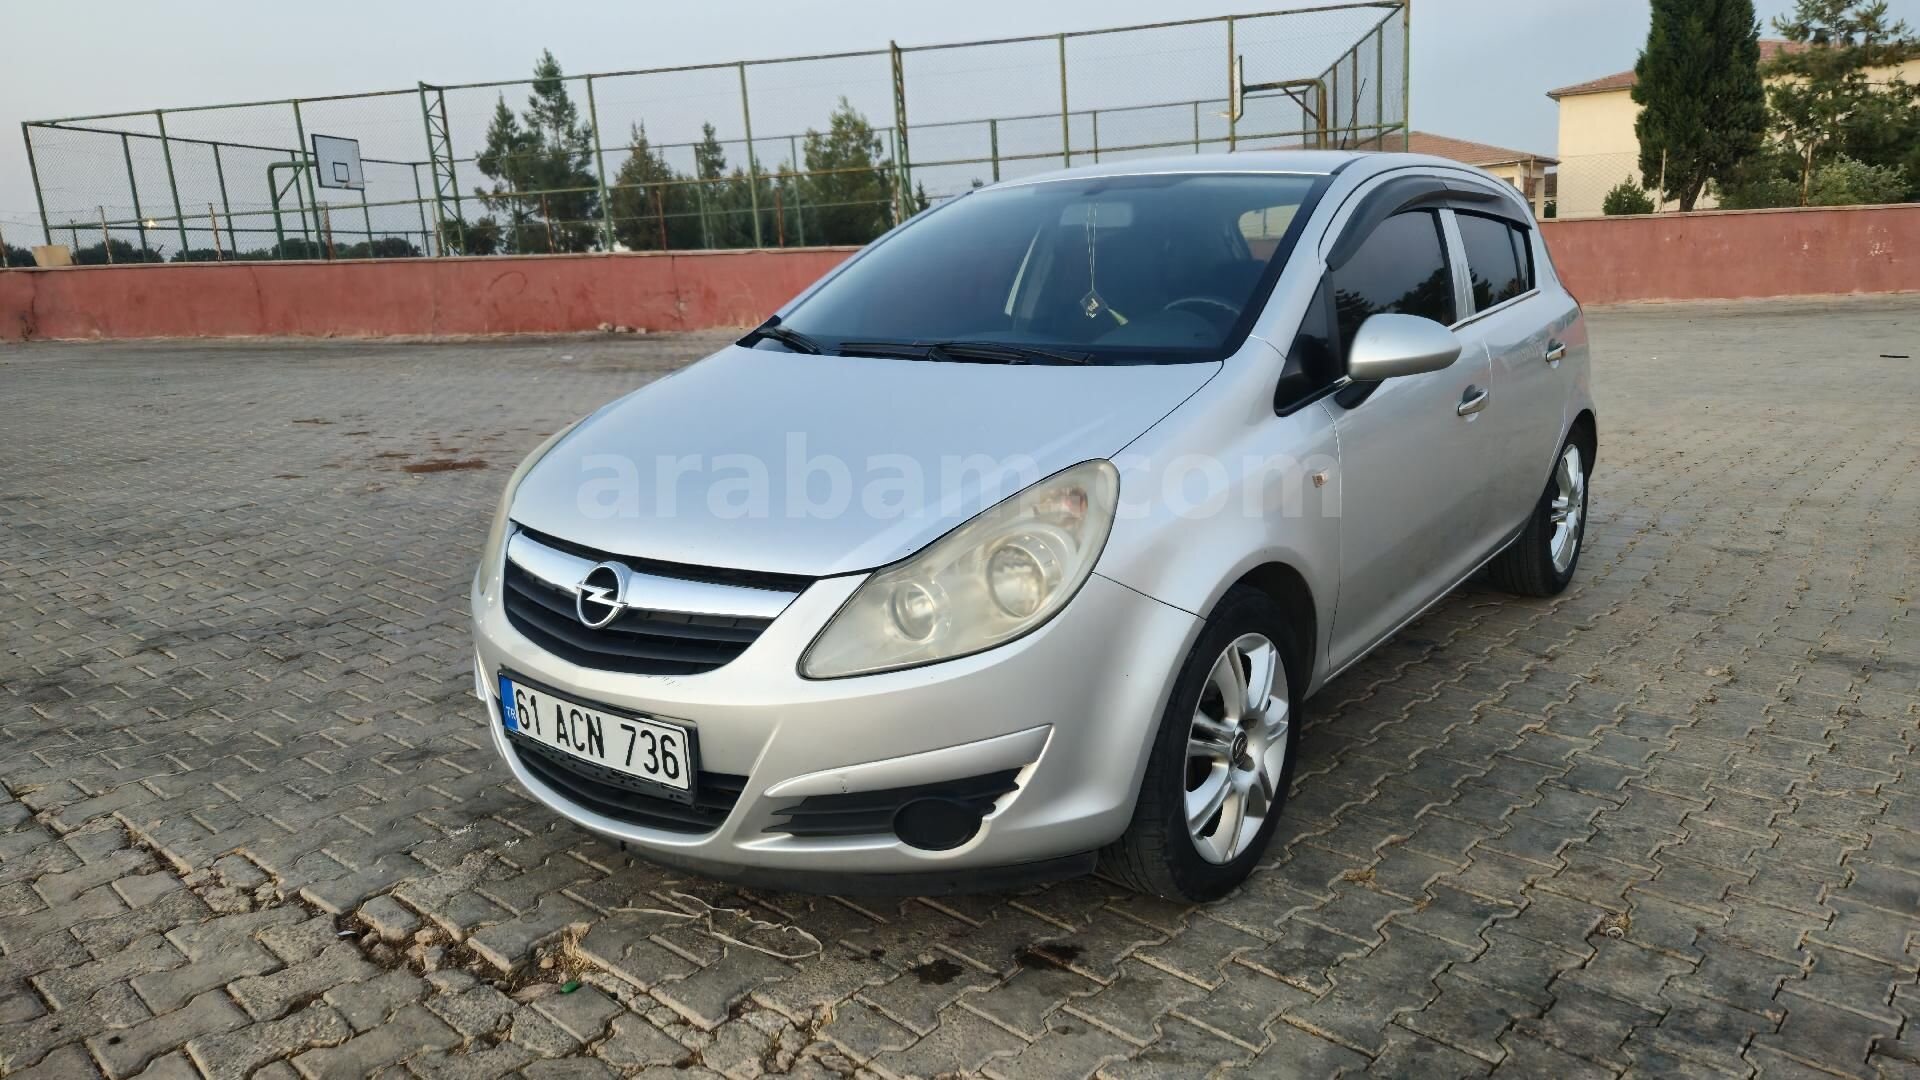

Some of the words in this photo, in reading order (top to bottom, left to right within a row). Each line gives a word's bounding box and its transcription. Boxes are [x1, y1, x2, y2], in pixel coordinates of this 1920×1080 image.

[505, 704, 517, 721] TR
[515, 688, 541, 736] 61
[556, 704, 605, 759] ACN
[620, 723, 680, 780] 736
